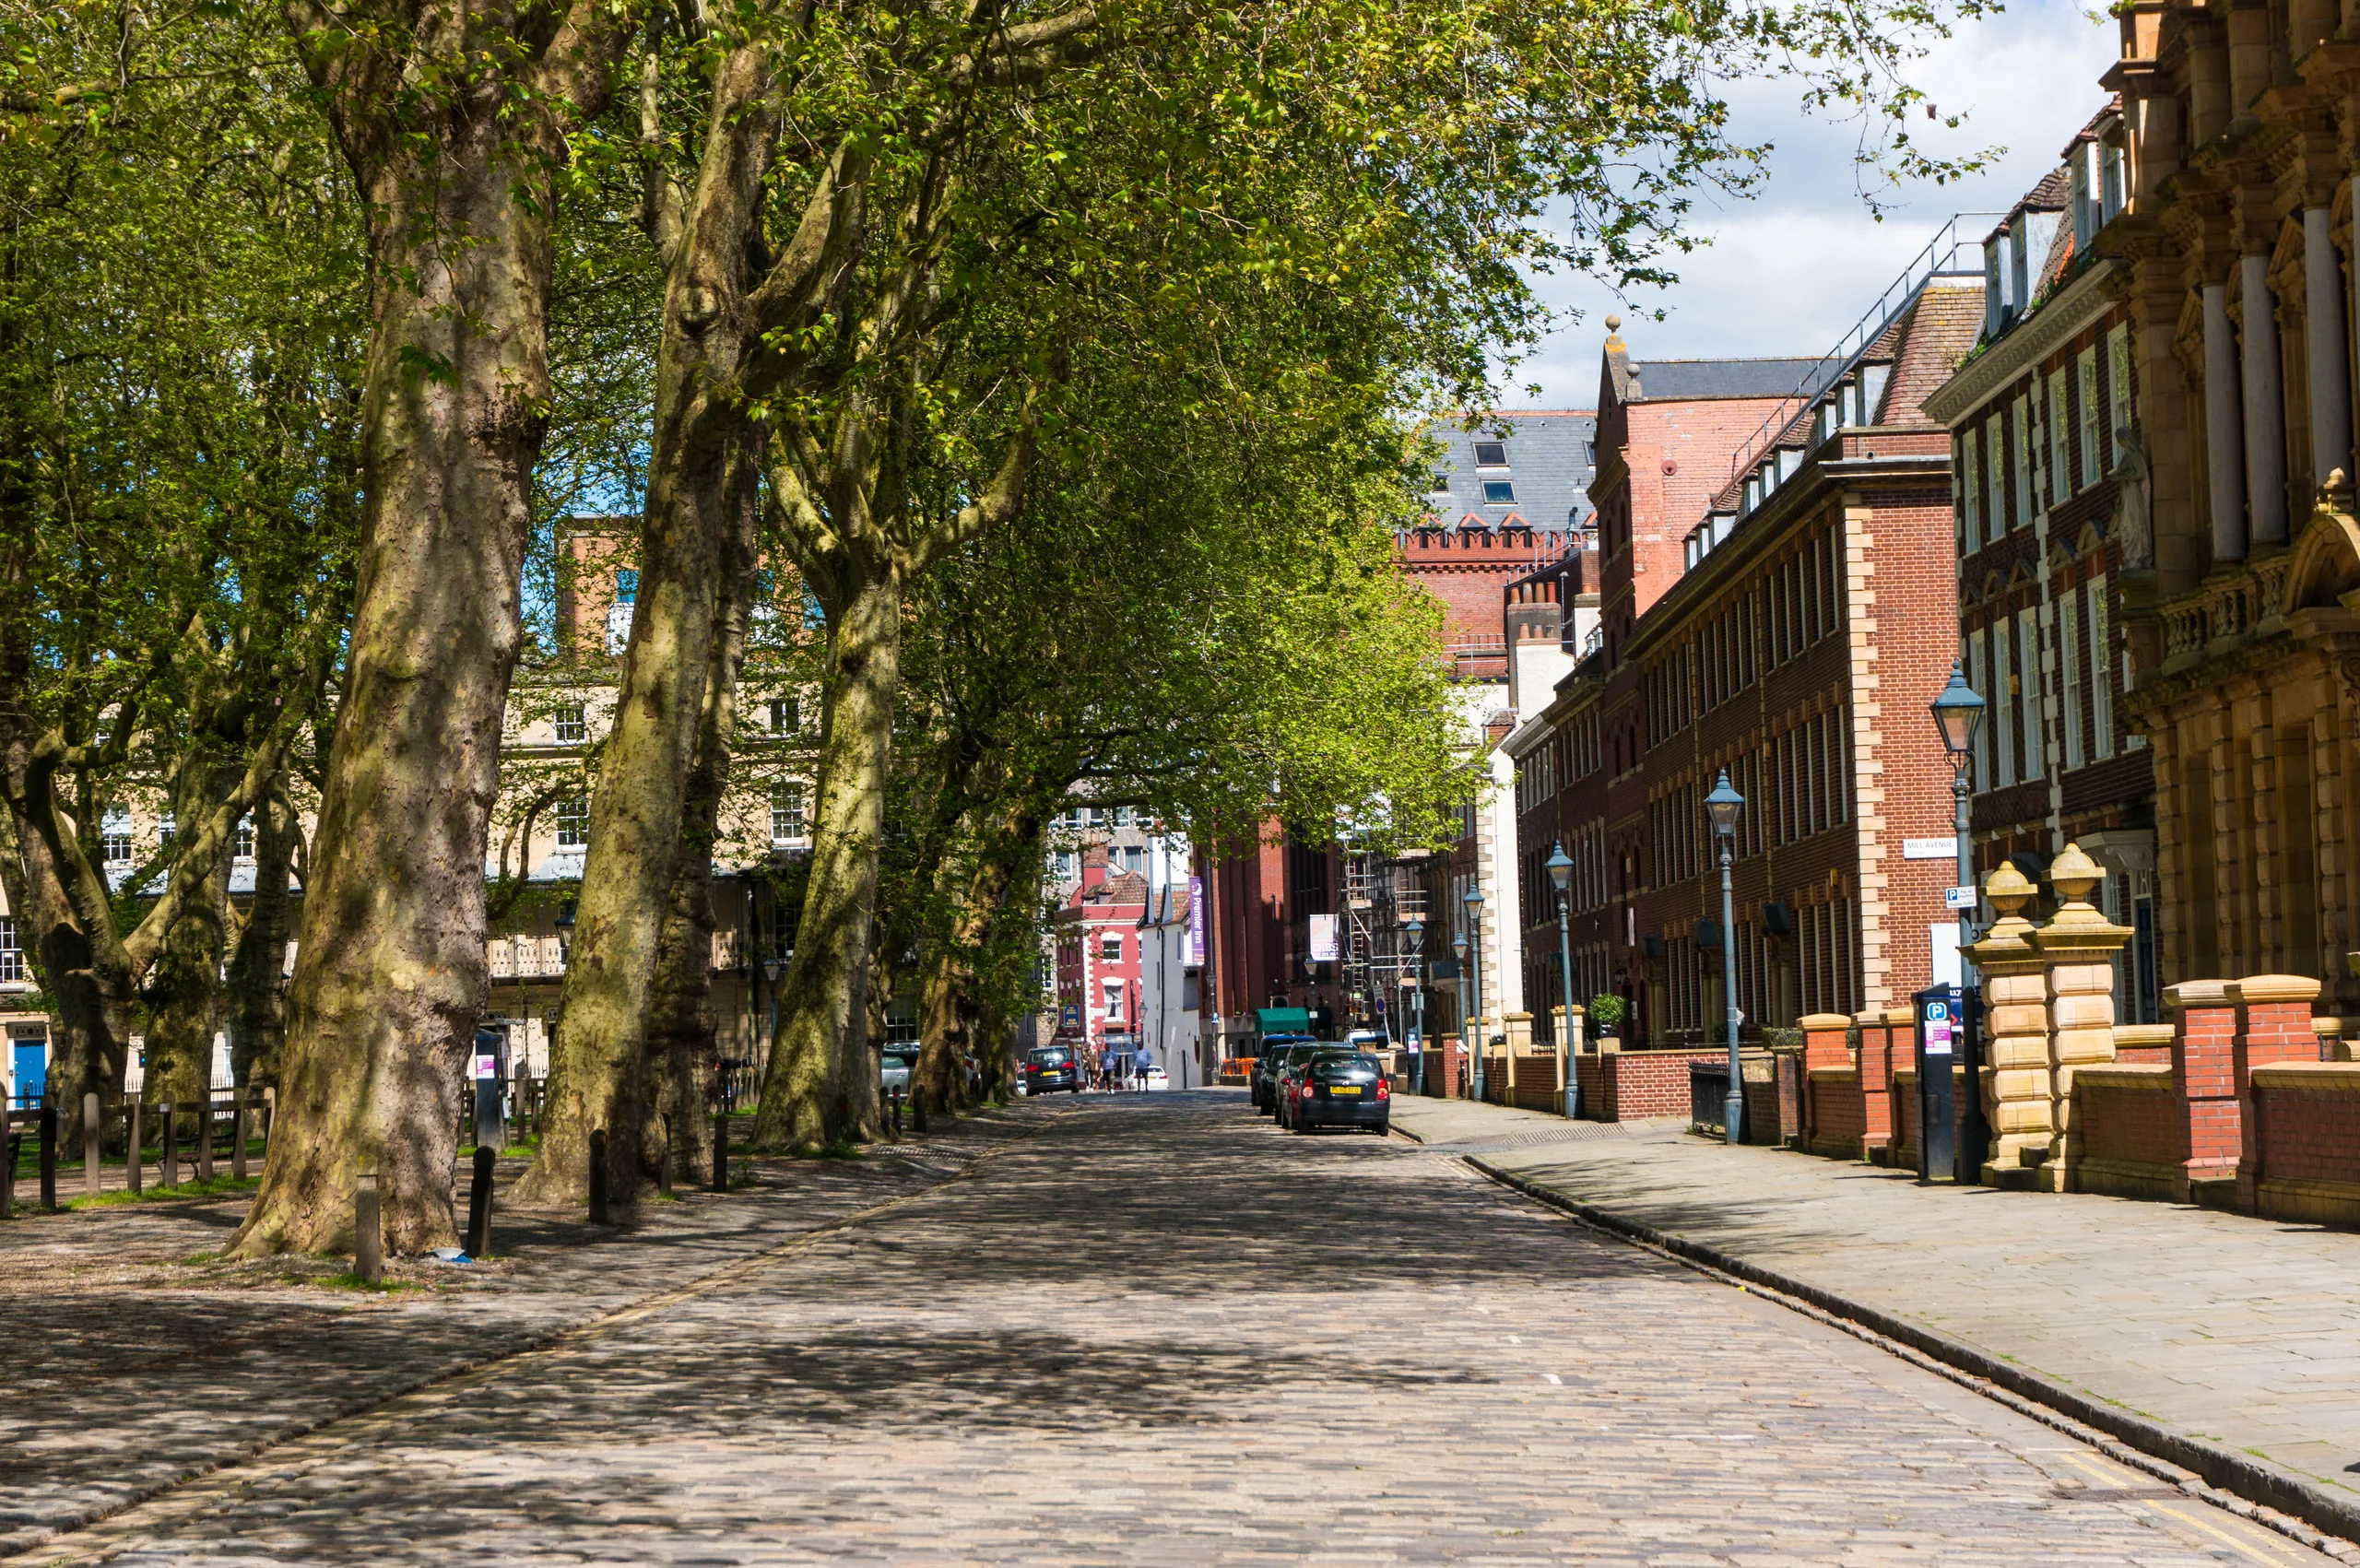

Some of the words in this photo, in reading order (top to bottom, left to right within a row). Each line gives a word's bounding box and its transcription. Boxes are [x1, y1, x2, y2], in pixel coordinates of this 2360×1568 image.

[1193, 897, 1202, 930] Premier
[1194, 930, 1203, 944] Inn
[1932, 1005, 1942, 1019] P
